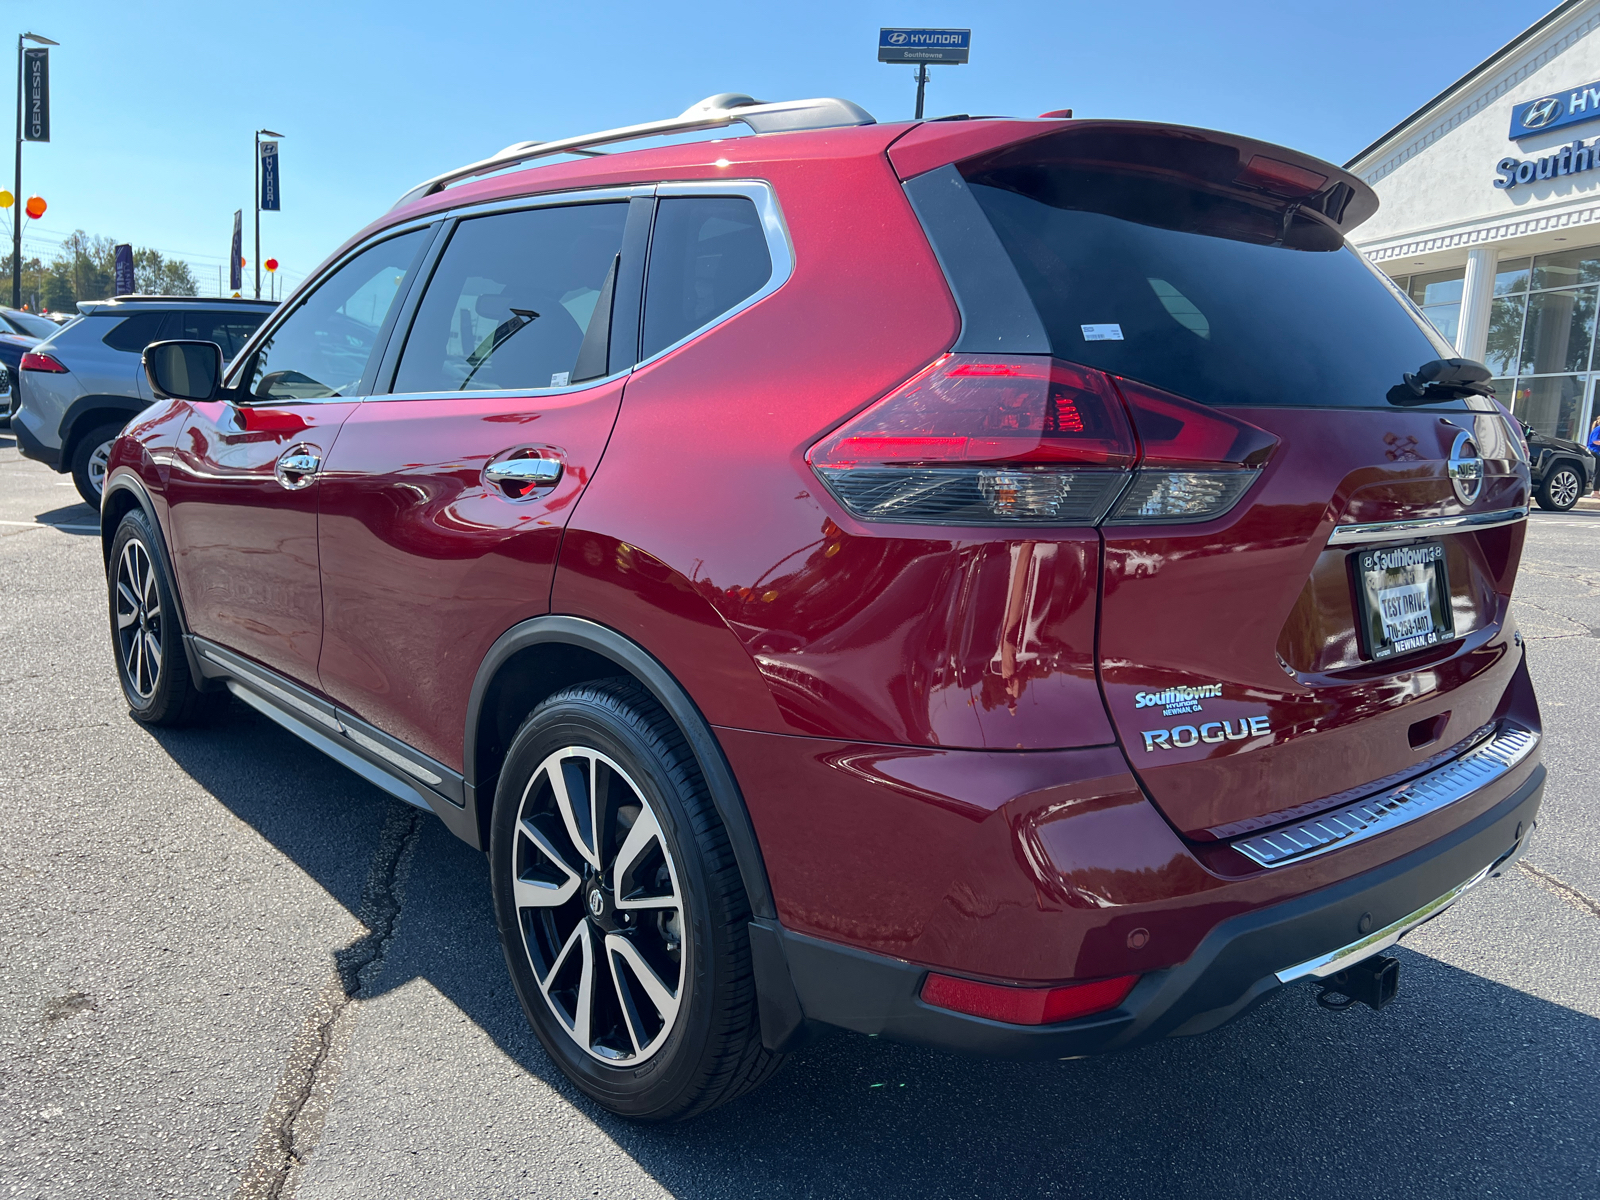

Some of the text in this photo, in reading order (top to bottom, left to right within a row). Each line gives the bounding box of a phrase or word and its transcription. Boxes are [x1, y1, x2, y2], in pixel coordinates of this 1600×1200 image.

[910, 34, 962, 44] HYUNDAI
[903, 51, 943, 59] Southtowne
[32, 60, 42, 138] GENESIS
[266, 156, 274, 209] HYUNDAI
[1382, 591, 1427, 619] TEST DRIVE
[1386, 615, 1430, 640] 770-253-1407
[1394, 634, 1428, 653] NEWNAN,
[1427, 632, 1438, 644] GA
[1162, 704, 1203, 717] NEWNAN, GA
[1166, 700, 1198, 709] HYUNDAI
[1140, 715, 1272, 753] ROGUE
